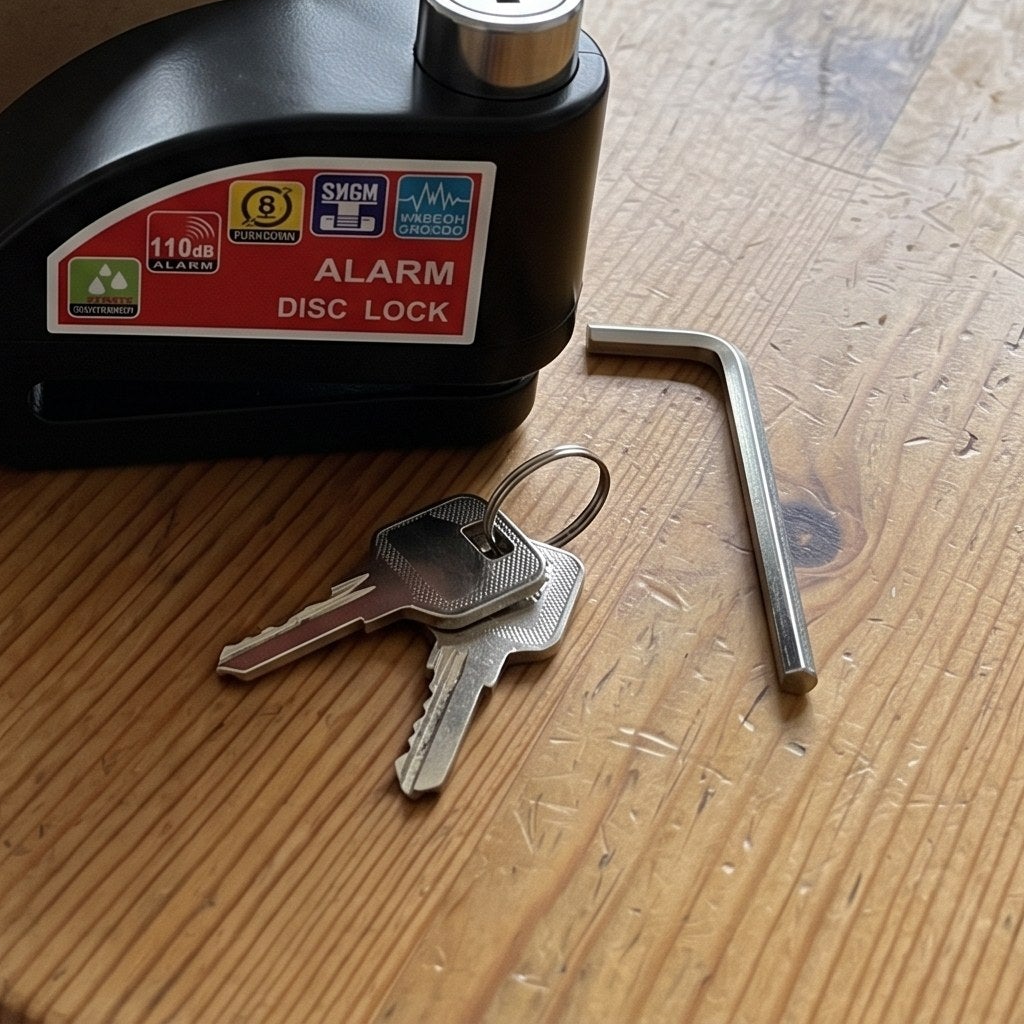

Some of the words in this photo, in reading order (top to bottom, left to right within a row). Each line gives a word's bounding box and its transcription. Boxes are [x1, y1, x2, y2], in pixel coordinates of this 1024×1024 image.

[150, 237, 214, 258] 110dB
[152, 261, 213, 270] ALARM
[314, 258, 455, 286] ALARM
[278, 297, 348, 320] DISC
[364, 300, 450, 323] LOCK
